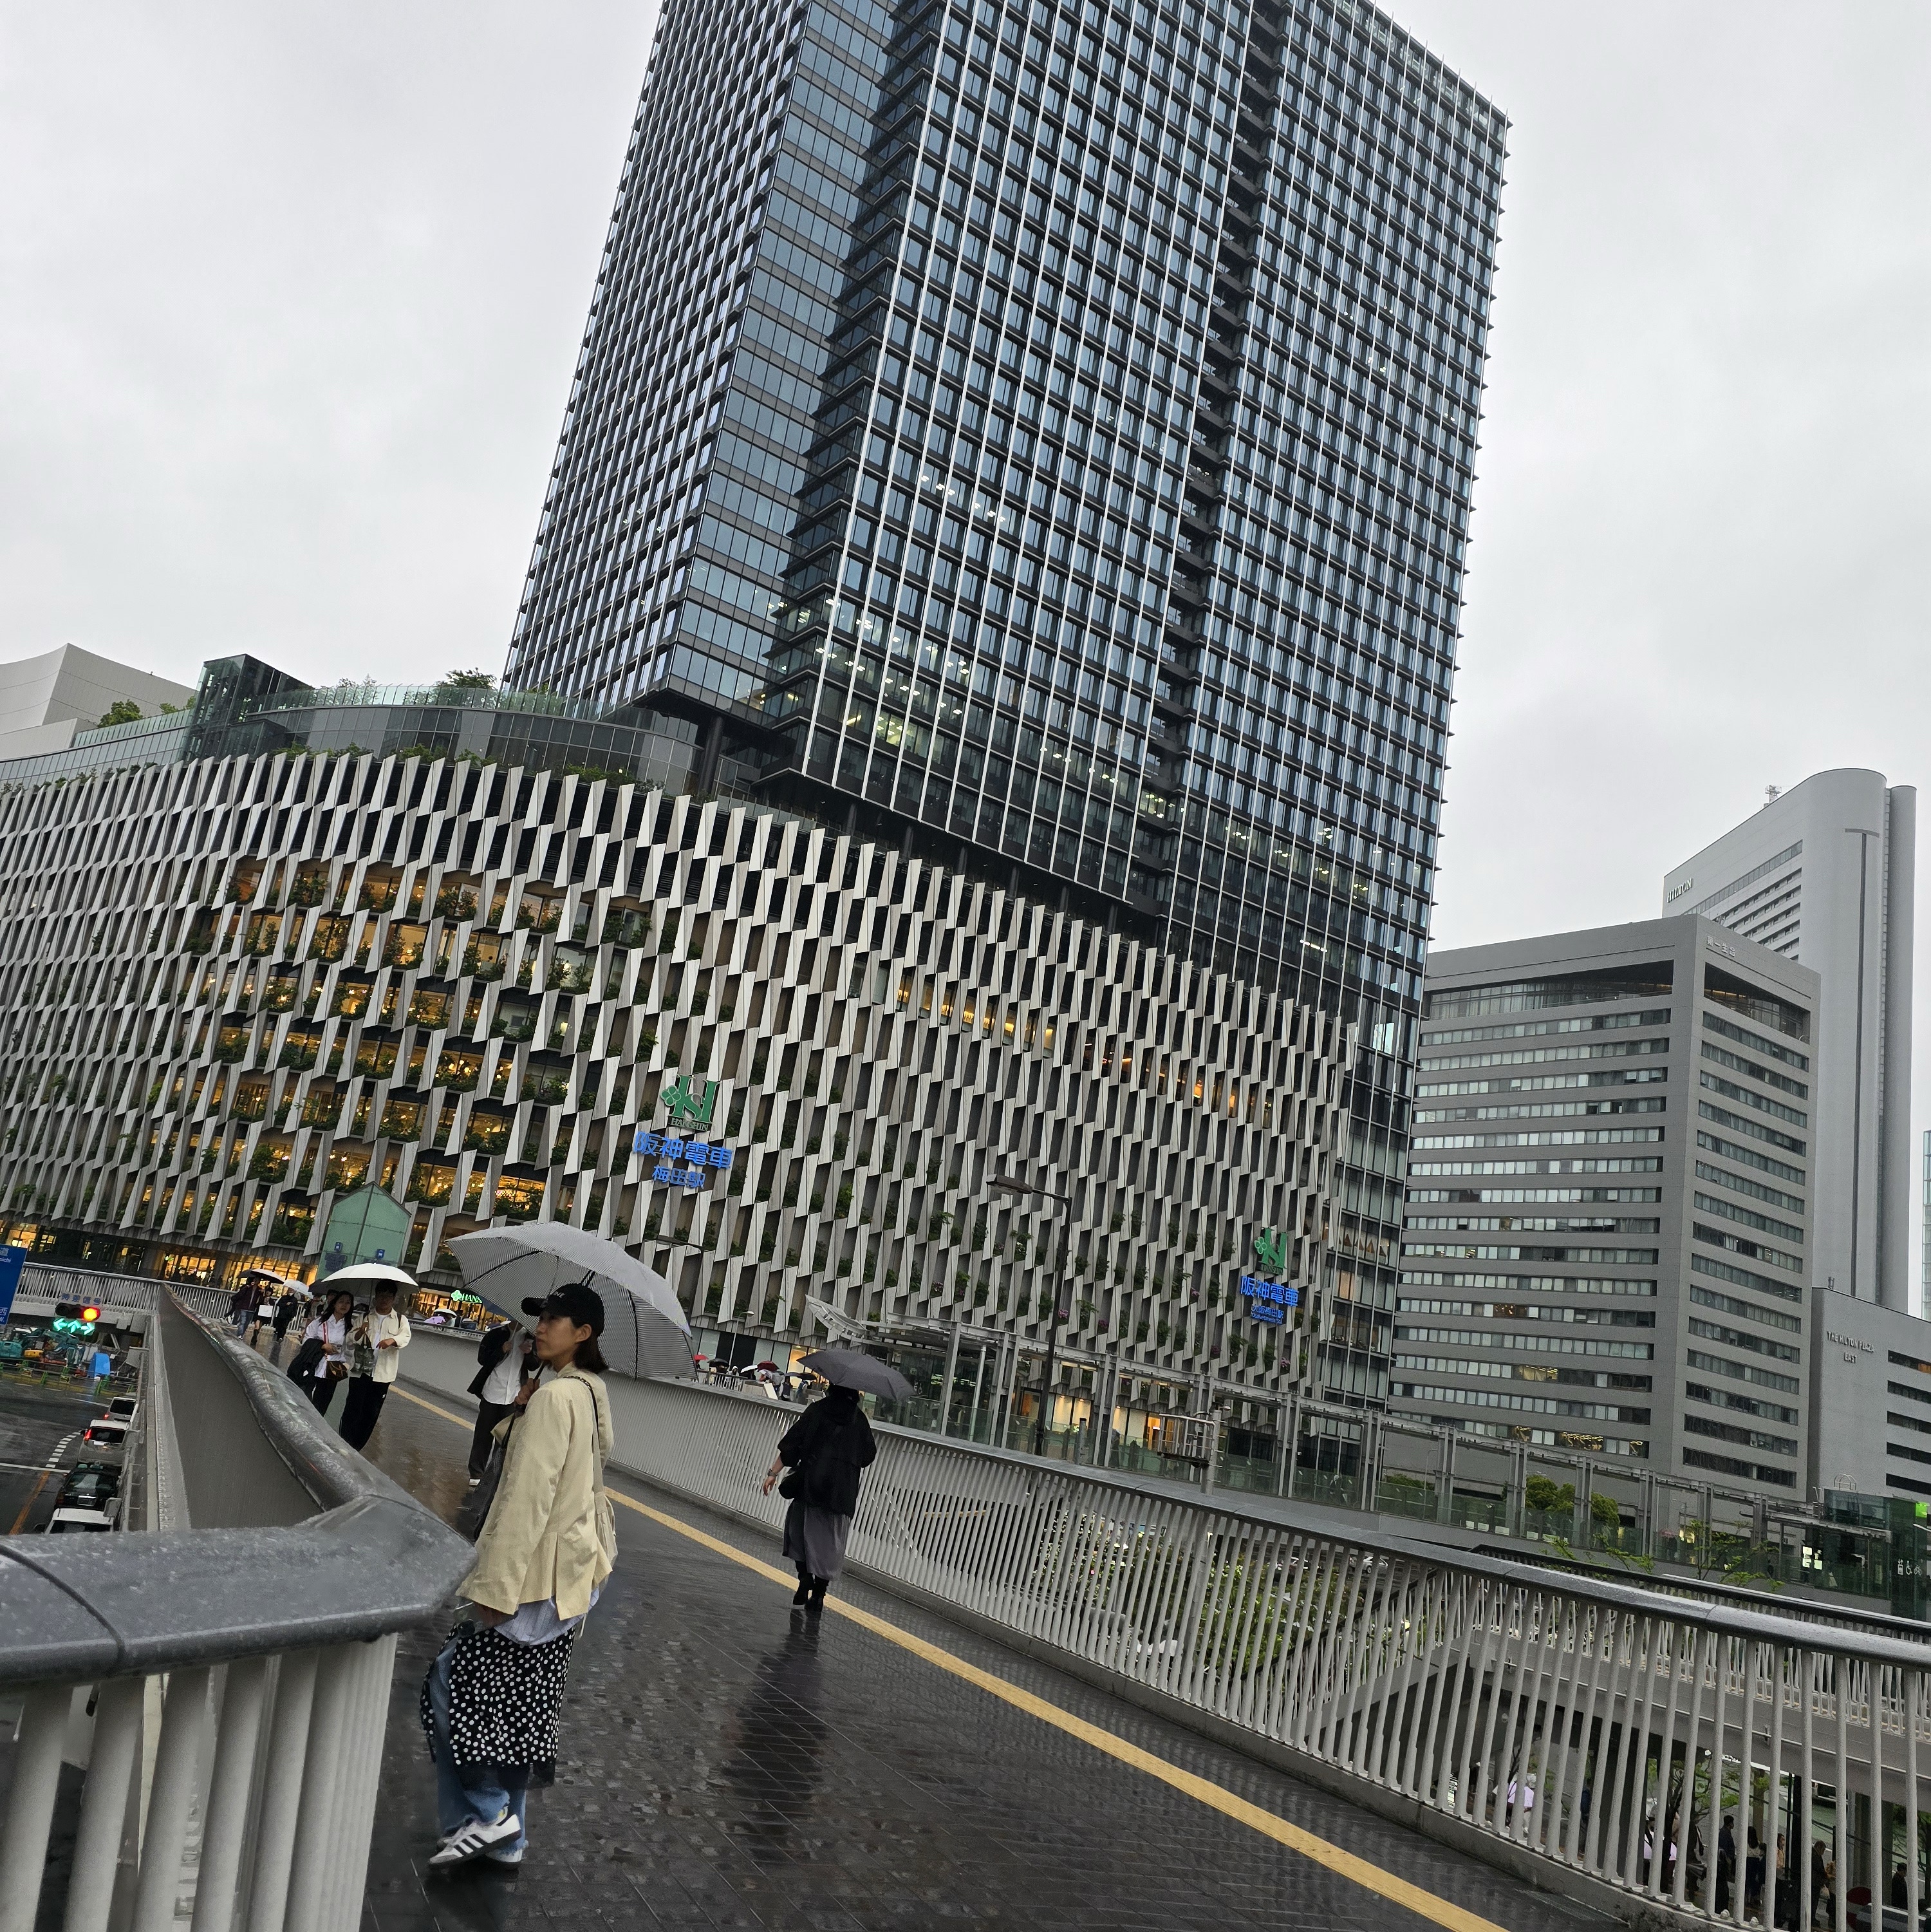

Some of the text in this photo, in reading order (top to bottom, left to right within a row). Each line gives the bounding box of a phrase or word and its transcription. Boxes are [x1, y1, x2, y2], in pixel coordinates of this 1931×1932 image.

[1667, 877, 1693, 903] HILTON
[671, 1117, 709, 1132] HANSHIN
[632, 1131, 732, 1168] 阪神電車
[652, 1164, 706, 1189] 梅田駅
[1240, 1275, 1300, 1306] 阪神電車
[1827, 1331, 1838, 1342] THE
[1839, 1335, 1858, 1348] HILTON
[1843, 1352, 1857, 1364] EAST
